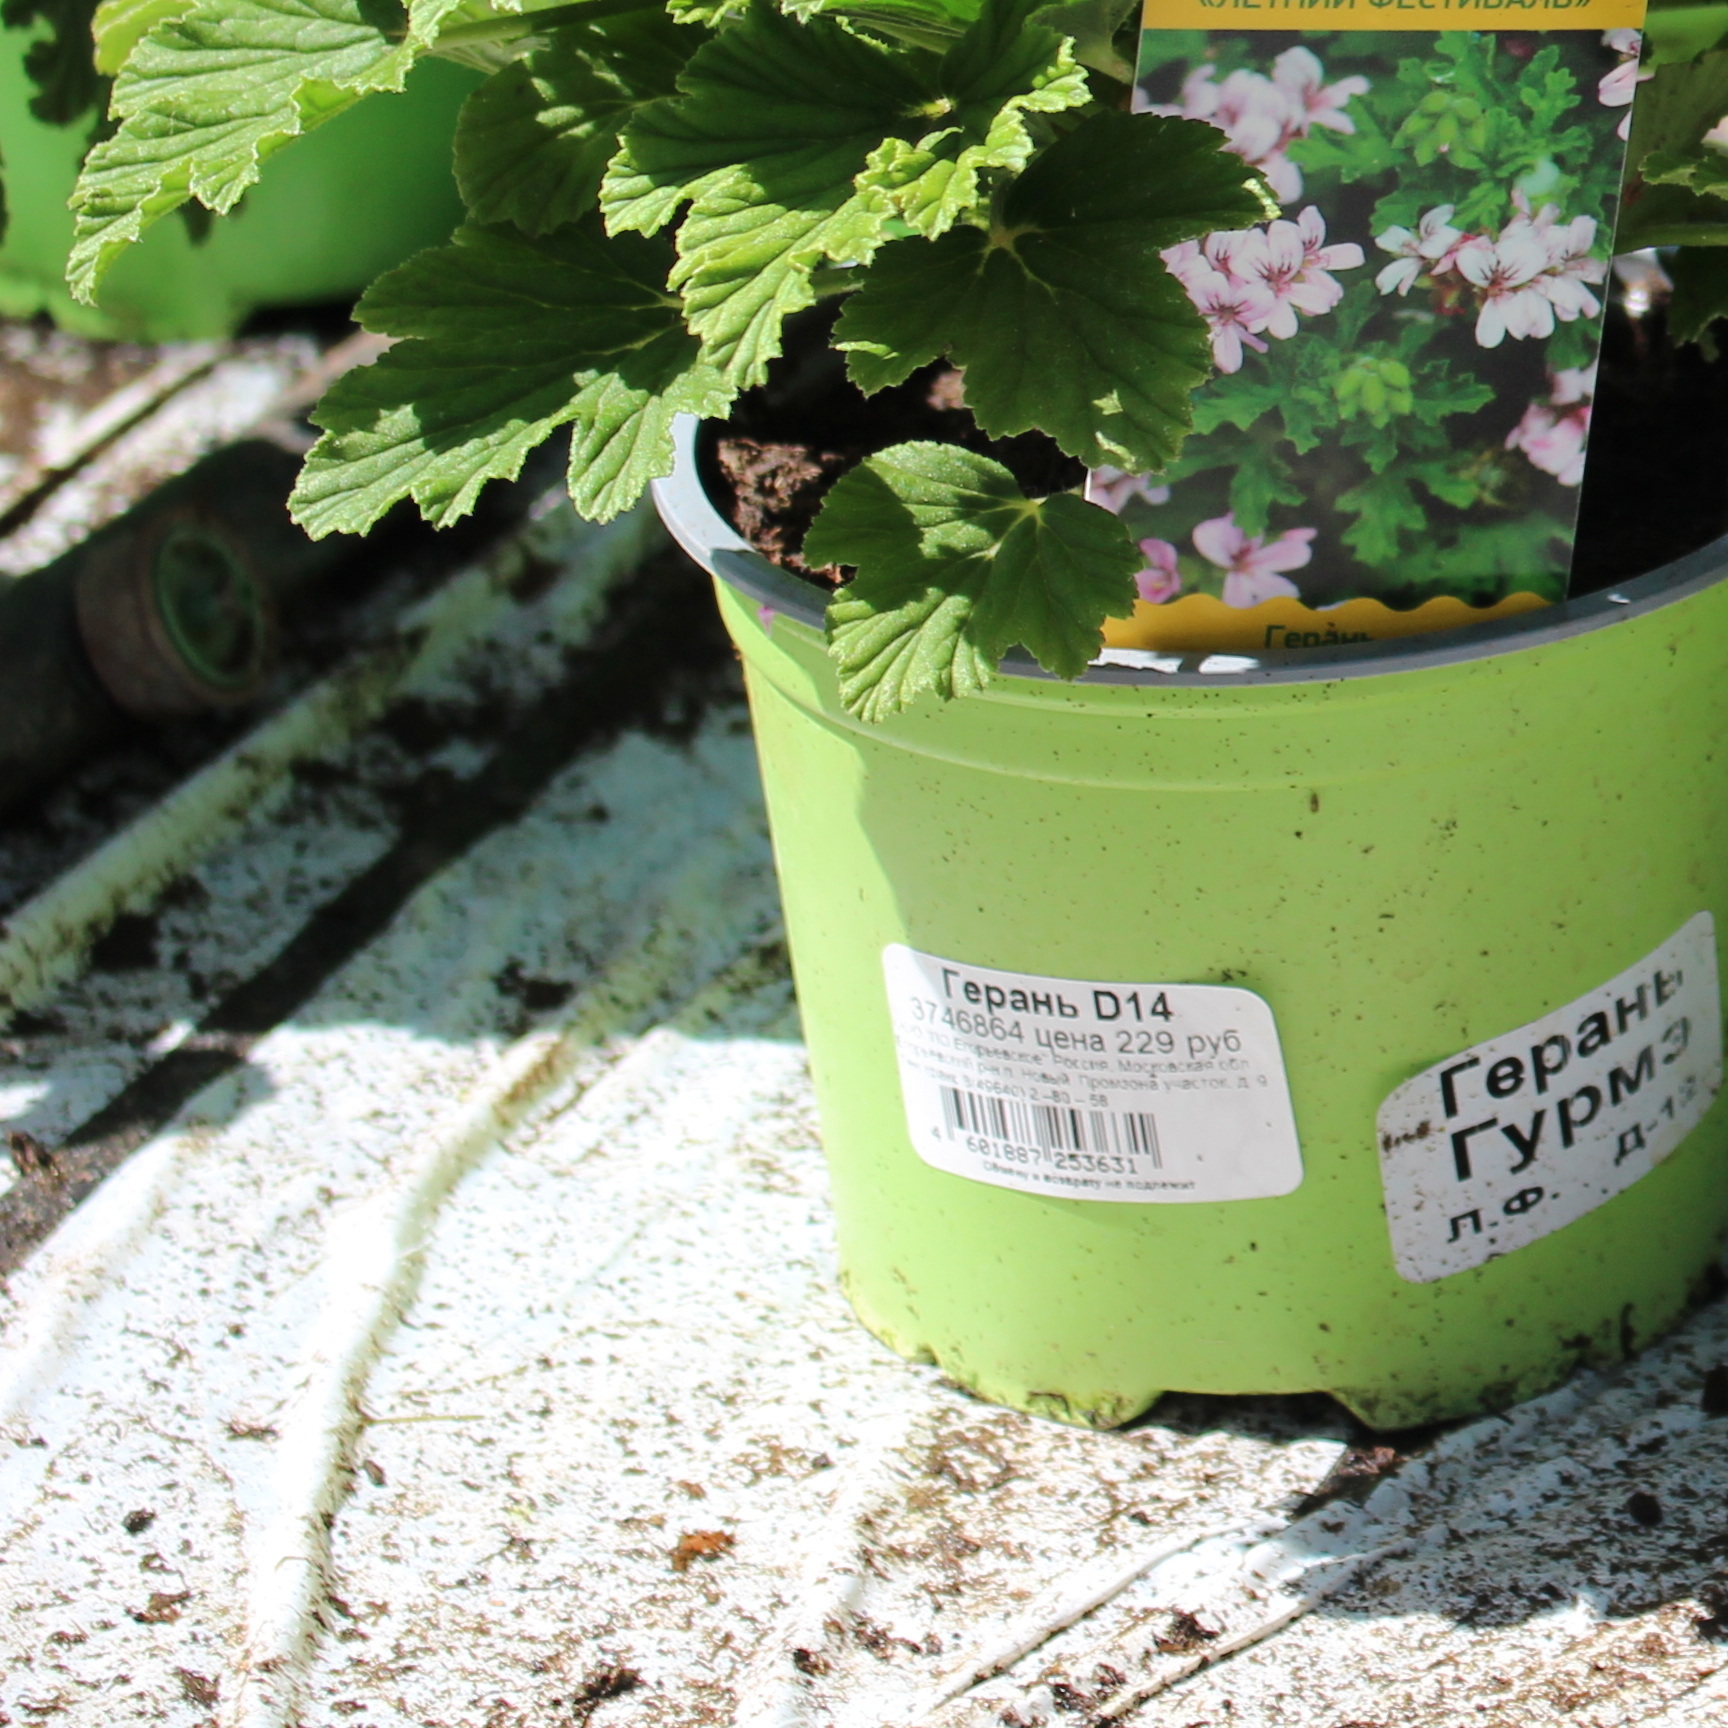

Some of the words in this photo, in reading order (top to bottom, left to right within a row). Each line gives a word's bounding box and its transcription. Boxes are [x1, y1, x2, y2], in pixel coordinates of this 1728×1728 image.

[941, 968, 1078, 1018] Герань
[1093, 989, 1173, 1023] D14
[910, 996, 1025, 1045] 3746864
[1035, 1026, 1106, 1057] цена
[1117, 1029, 1174, 1055] 229
[1187, 1029, 1241, 1059] руб
[1439, 970, 1684, 1119] Герань
[1450, 1016, 1692, 1182] Гурмэ
[966, 1136, 1041, 1166] 601887
[1053, 1153, 1138, 1174] 253631
